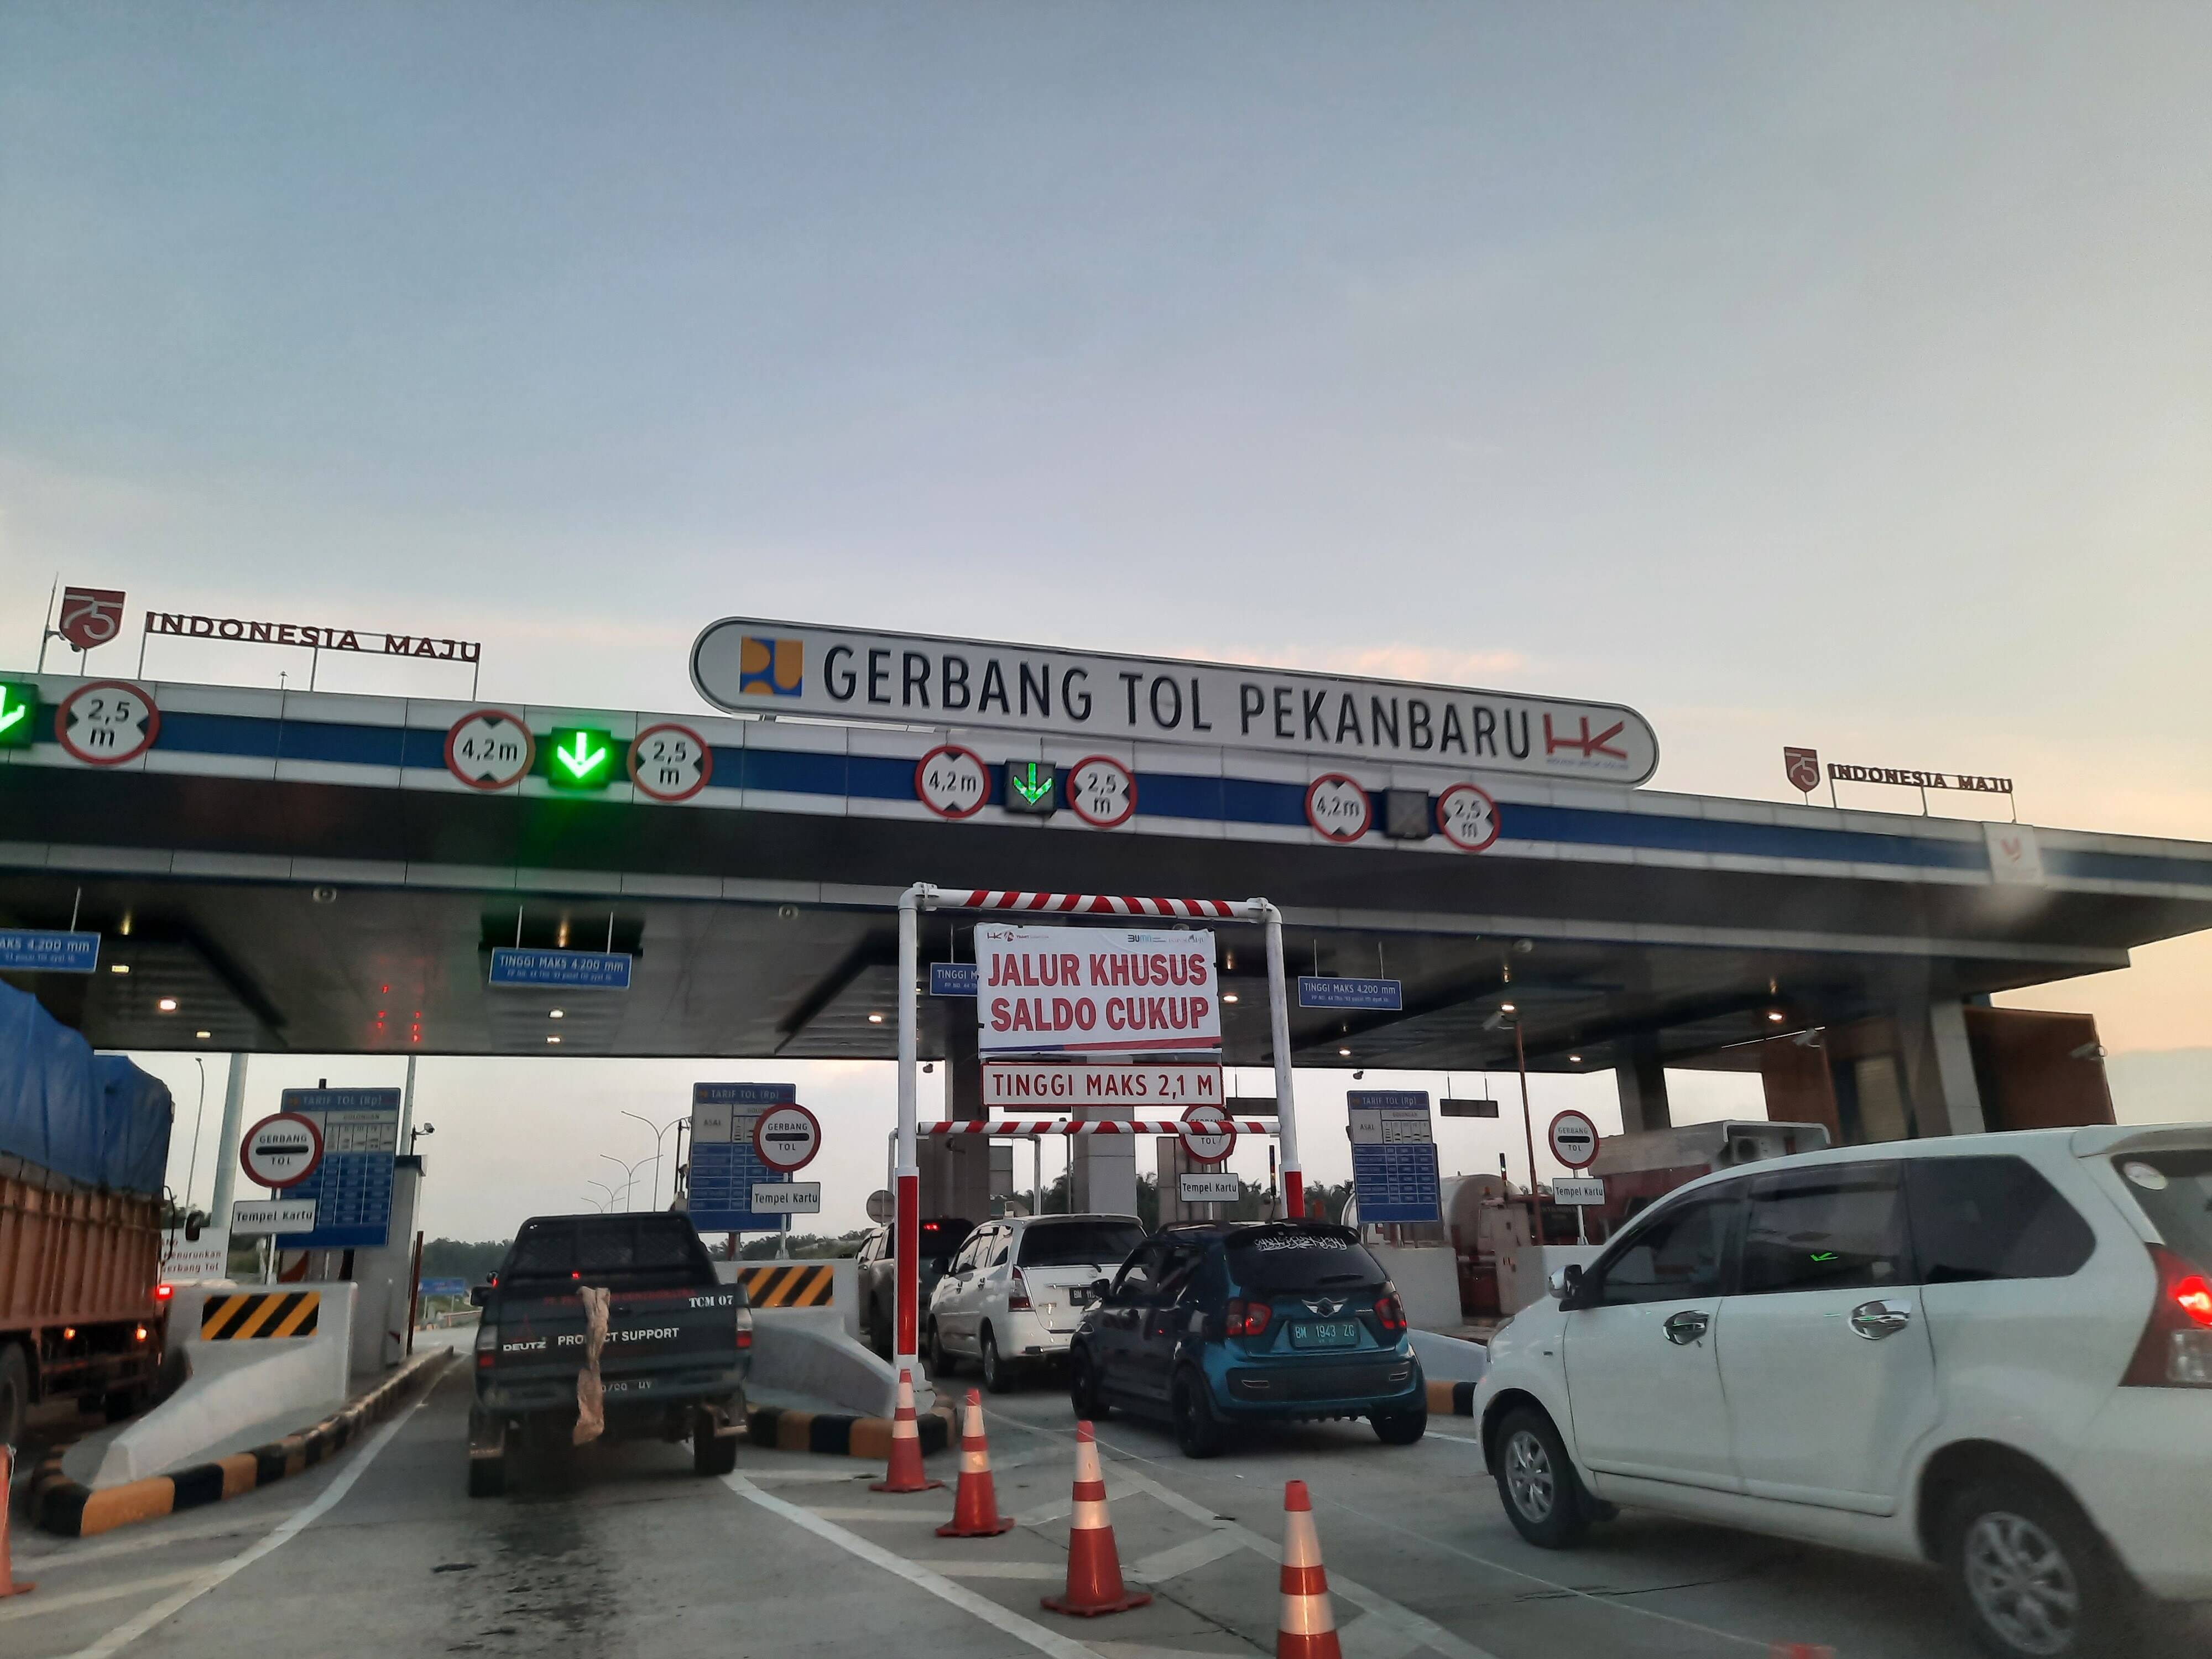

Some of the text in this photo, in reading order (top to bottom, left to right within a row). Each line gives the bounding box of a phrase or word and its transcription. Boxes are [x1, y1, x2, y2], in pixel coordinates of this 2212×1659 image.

[146, 612, 481, 662] INDONESIA MAJU
[823, 644, 1532, 761] GERBANG TOL PEKANBARU
[87, 698, 131, 724] 2,5
[90, 727, 115, 748] m
[653, 740, 687, 765] 2,5
[659, 767, 680, 785] m
[1087, 772, 1117, 796] 2,5
[1828, 763, 2013, 794] INDONESIA MAJU
[1093, 797, 1110, 814] m
[1454, 799, 1481, 821] 2,5
[1461, 822, 1479, 838] m
[499, 954, 535, 968] TINGGI
[539, 956, 567, 970] MAKS
[604, 961, 624, 973] mm
[988, 953, 1207, 987] JALUR KHUSUS
[937, 969, 967, 979] TINGGI
[1304, 983, 1396, 995] TINGGI MAKS 4.200 mm
[990, 996, 1209, 1032] SALDO CUKUP
[712, 1089, 779, 1099] TARIF TOL (Rp)
[992, 1073, 1213, 1100] TINGGI MAKS 2,1 M
[304, 1095, 382, 1107] TARIF TOL (Rp)
[1363, 1097, 1416, 1106] TARIF TOL (Rp)
[768, 1123, 808, 1131] GERBANG
[259, 1134, 307, 1144] GERBANG
[272, 1156, 290, 1165] TOL
[1182, 1182, 1237, 1194] Tempel Kartu
[1556, 1187, 1603, 1198] Tempel Kartu
[755, 1193, 818, 1205] Tempel Kartu
[237, 1210, 313, 1223] Tempel Kartu
[688, 1295, 734, 1308] TCM 07
[1073, 1290, 1082, 1298] BM
[503, 1327, 680, 1352] DEUTZ PROCT SUPPORT
[1295, 1324, 1355, 1339] BM 1943 ZG
